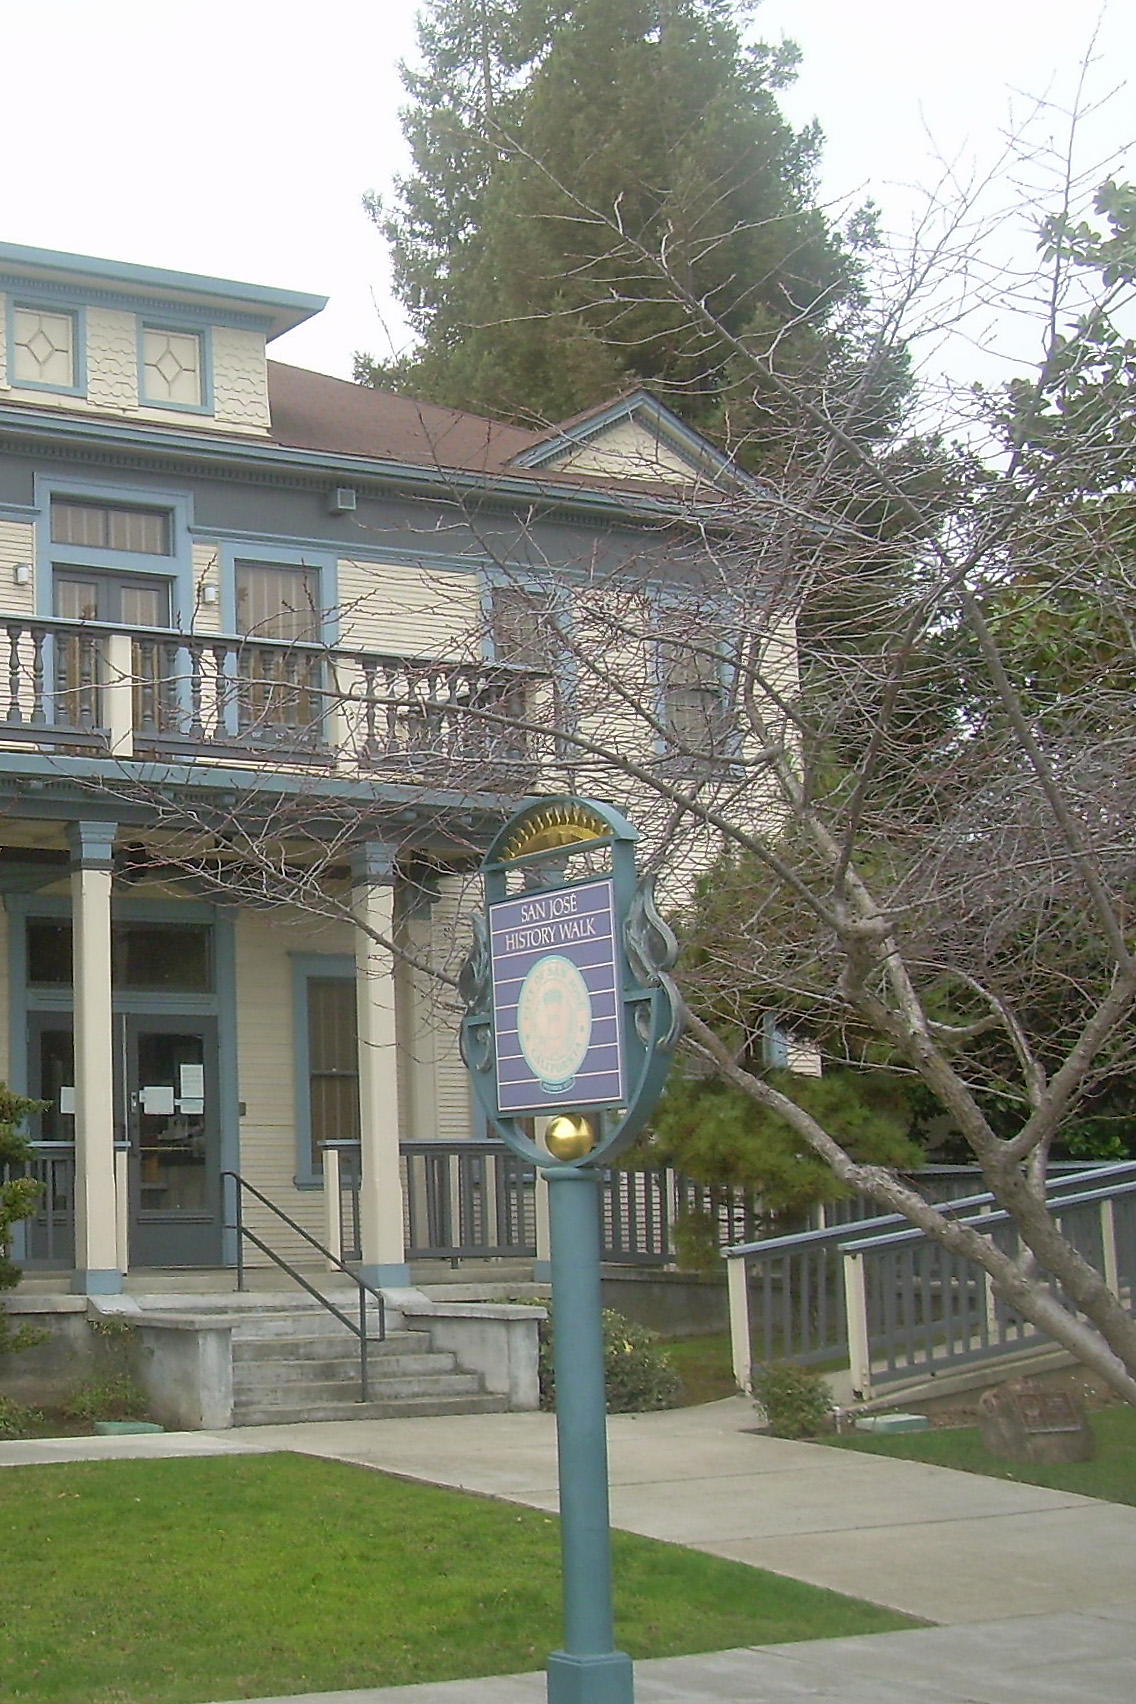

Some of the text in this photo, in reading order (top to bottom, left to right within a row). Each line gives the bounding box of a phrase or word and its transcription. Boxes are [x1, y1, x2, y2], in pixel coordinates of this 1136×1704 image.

[521, 893, 578, 923] SAN JOSÉ
[505, 917, 596, 951] HISTORY WALK
